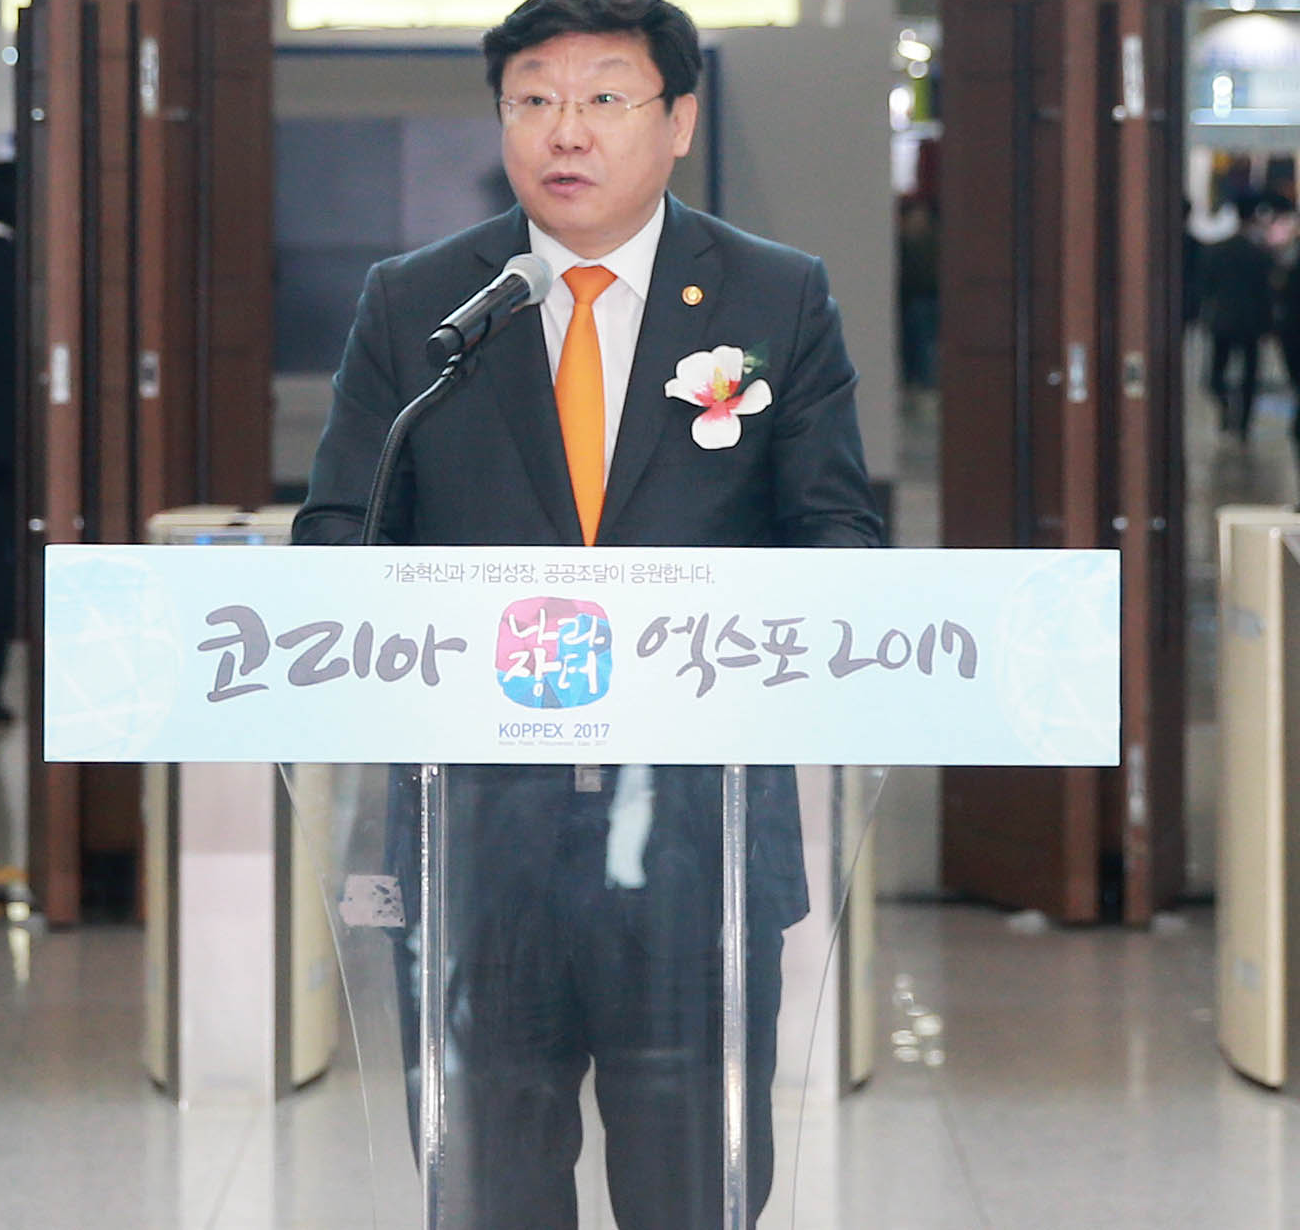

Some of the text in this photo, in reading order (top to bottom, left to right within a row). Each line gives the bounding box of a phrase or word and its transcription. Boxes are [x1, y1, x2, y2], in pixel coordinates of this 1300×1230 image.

[384, 562, 465, 583] 기술혁신과
[543, 563, 625, 584] 공공조달이
[630, 563, 716, 584] 응원합니다.
[197, 605, 977, 702] 코리아 엑스포 2017
[499, 722, 611, 739] KOPPEX 2017
